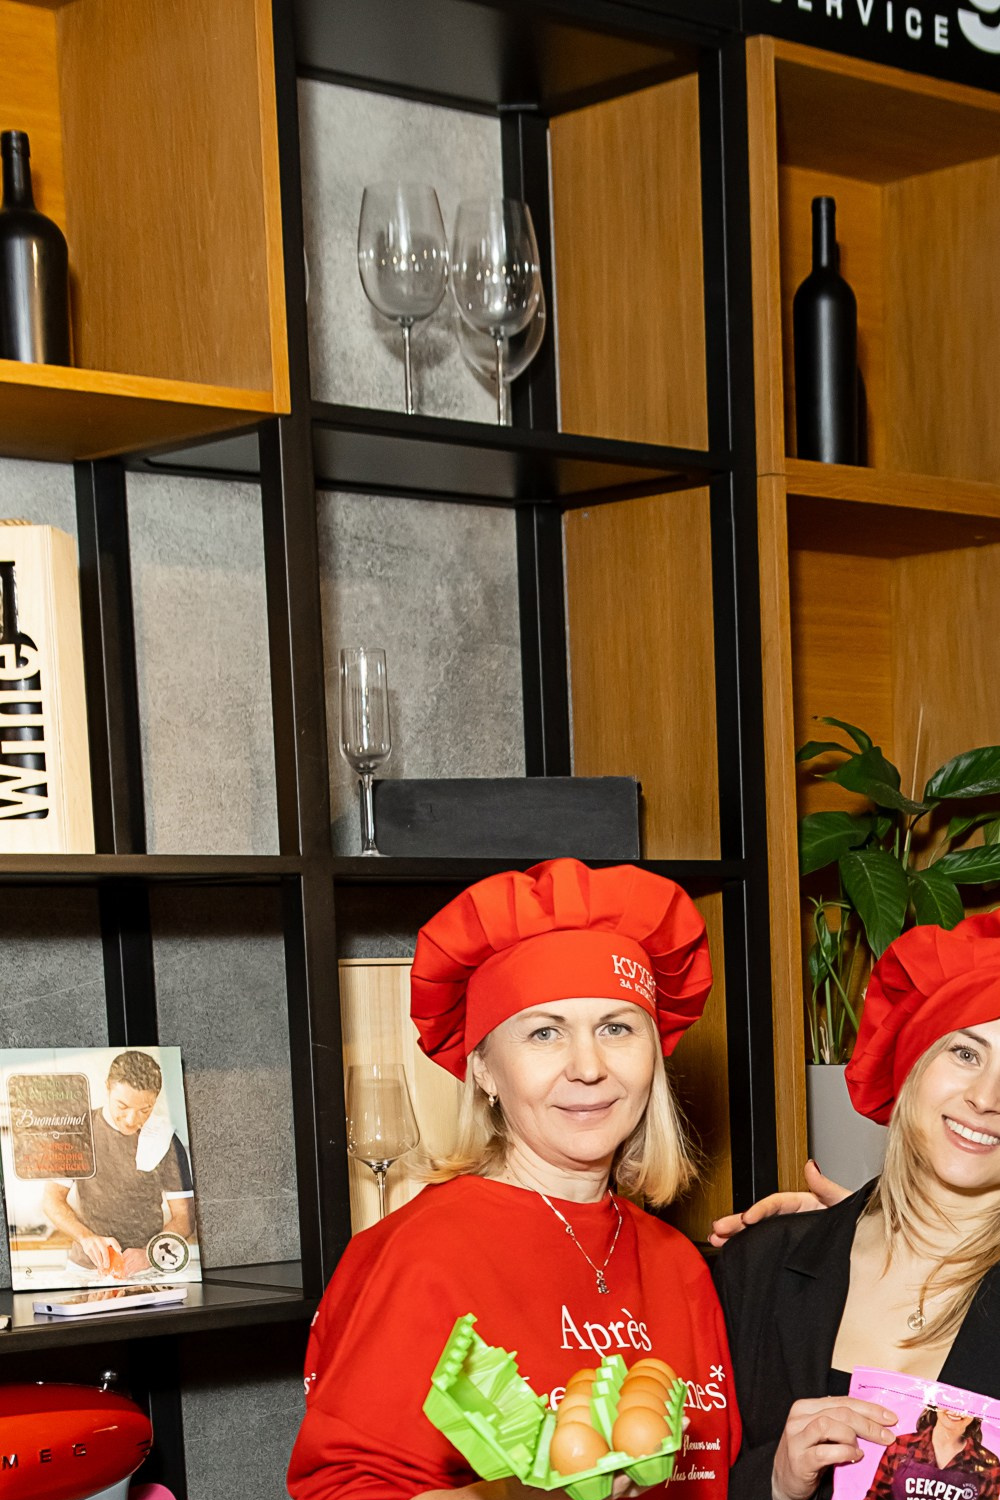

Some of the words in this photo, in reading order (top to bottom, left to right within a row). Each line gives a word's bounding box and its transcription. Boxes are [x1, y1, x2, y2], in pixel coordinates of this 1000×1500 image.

[770, 0, 949, 48] RVICE
[16, 1108, 86, 1128] Buonissimo!
[560, 1304, 652, 1358] Après
